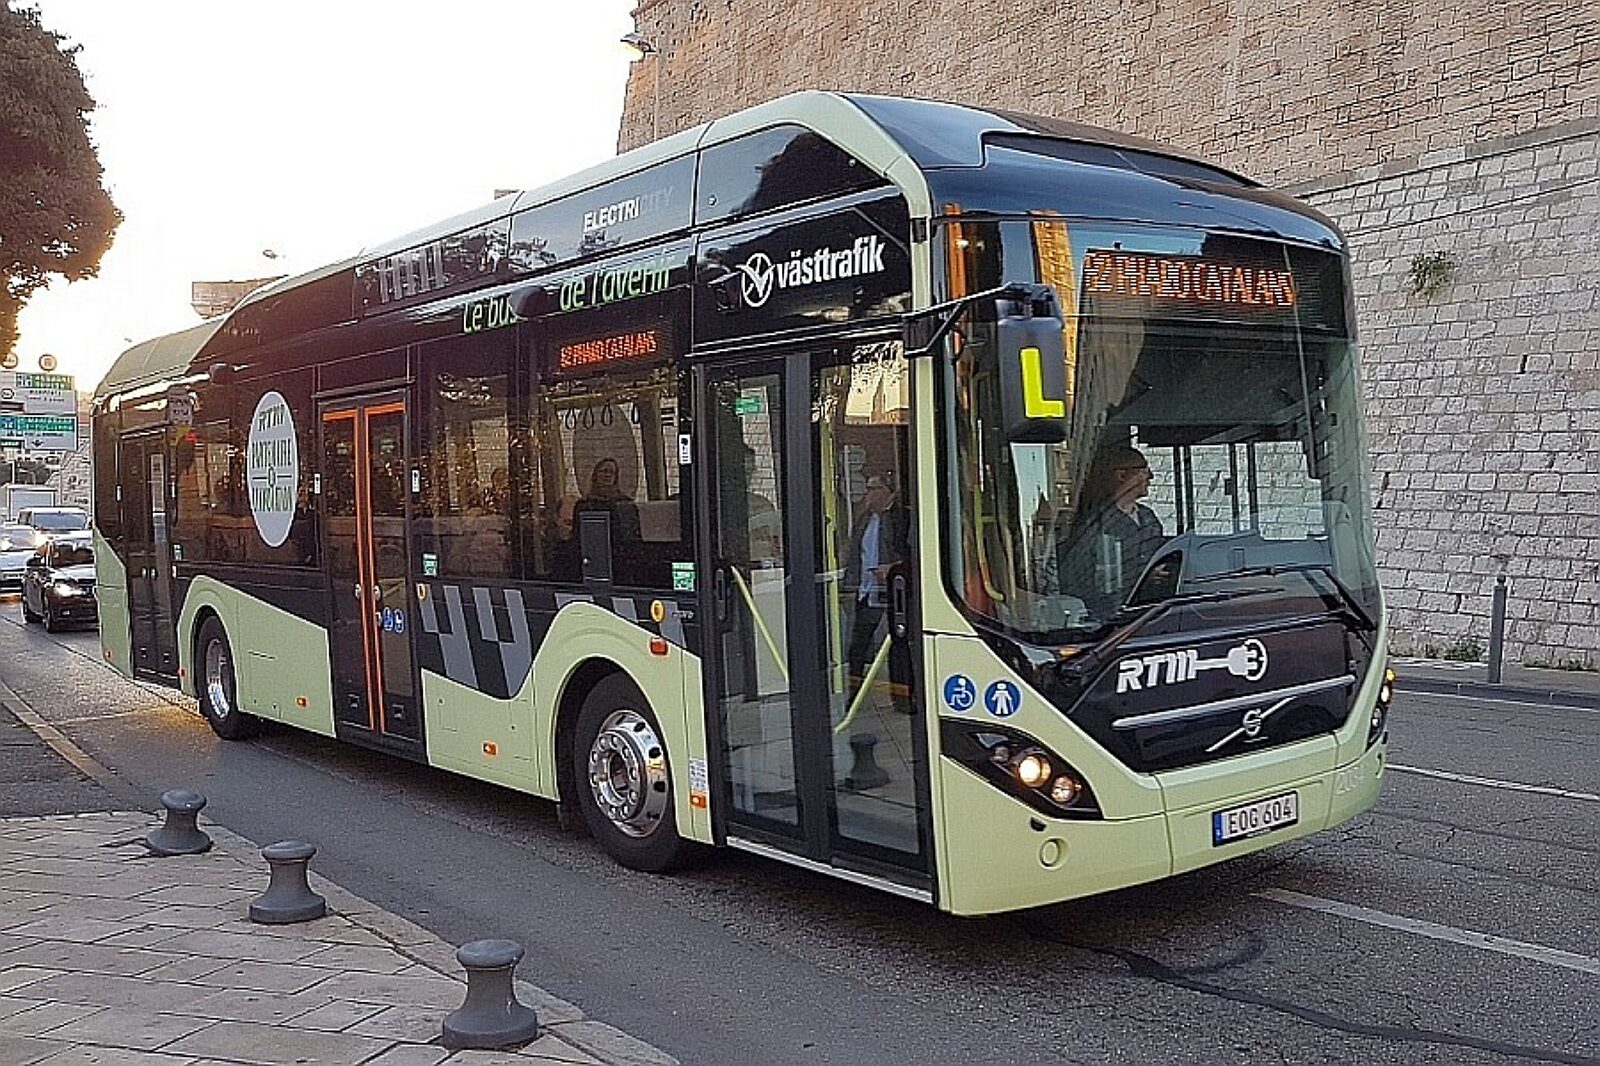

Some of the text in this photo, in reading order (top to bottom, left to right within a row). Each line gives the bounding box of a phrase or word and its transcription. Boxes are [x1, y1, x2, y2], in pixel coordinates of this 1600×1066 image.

[777, 235, 886, 289] västtrafik
[463, 301, 483, 333] Le
[560, 271, 586, 312] de
[1116, 650, 1199, 694] RTM
[1228, 797, 1292, 834] EOG 604
